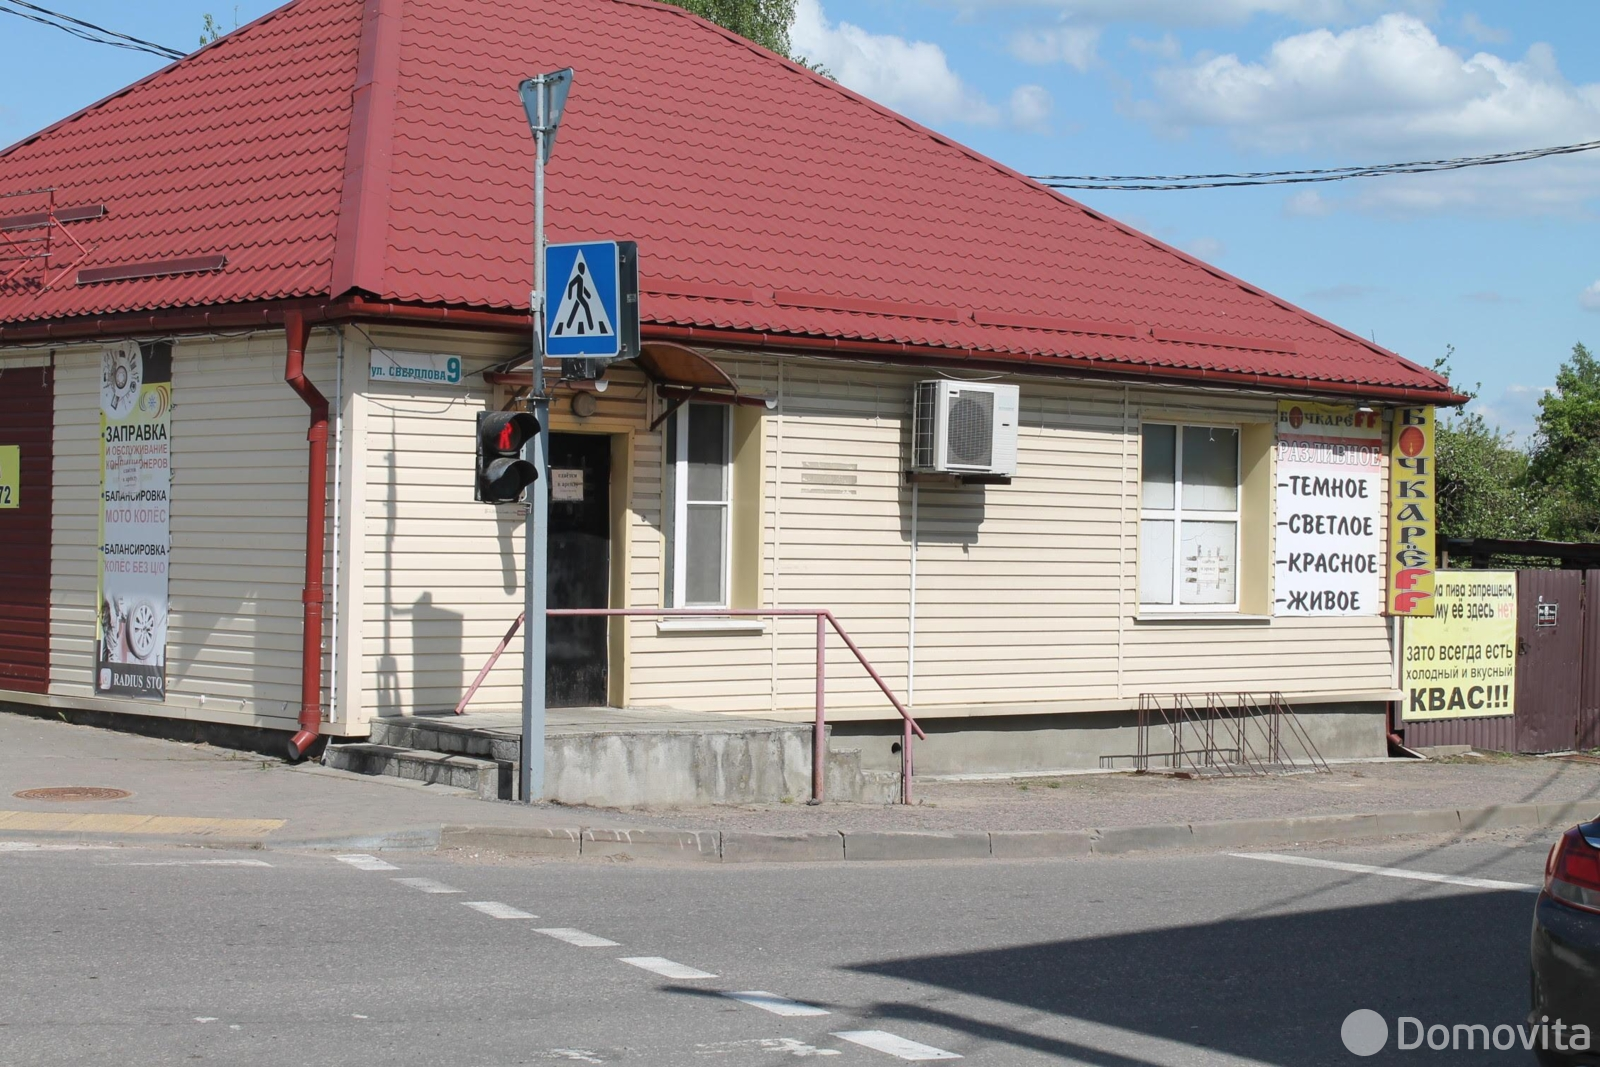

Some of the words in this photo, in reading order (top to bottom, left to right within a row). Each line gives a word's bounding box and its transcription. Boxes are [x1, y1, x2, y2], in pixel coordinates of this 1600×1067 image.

[371, 366, 386, 377] ул.
[446, 357, 461, 383] 9
[105, 423, 167, 443] ЗАПРАВКА
[105, 446, 111, 456] И
[111, 443, 168, 457] ОБСЛУЖИВАНИЕ
[1277, 441, 1380, 467] РАЗЛИВНОЕ
[105, 490, 167, 502] БАЛАНСИРОВКА
[105, 509, 132, 523] МОТО
[134, 506, 166, 523] КОЛЁС
[104, 543, 166, 556] БАЛАНСИРОВКА
[104, 559, 131, 573] КОЛЁС
[132, 561, 149, 574] БЕЗ
[150, 561, 166, 576] Ц/О
[1445, 584, 1465, 598] пива
[1468, 583, 1514, 601] запрещена,
[1451, 598, 1464, 619] её
[1466, 602, 1494, 622] здесь
[1497, 602, 1514, 617] нет
[1406, 645, 1436, 662] зато
[1439, 643, 1482, 664] всегда
[1485, 643, 1514, 660] есть
[113, 672, 163, 692] RADIUS_STO
[1405, 665, 1460, 682] холодный
[1461, 667, 1468, 679] и
[1470, 663, 1514, 681] вкусный
[1409, 684, 1510, 713] КВАС!!!
